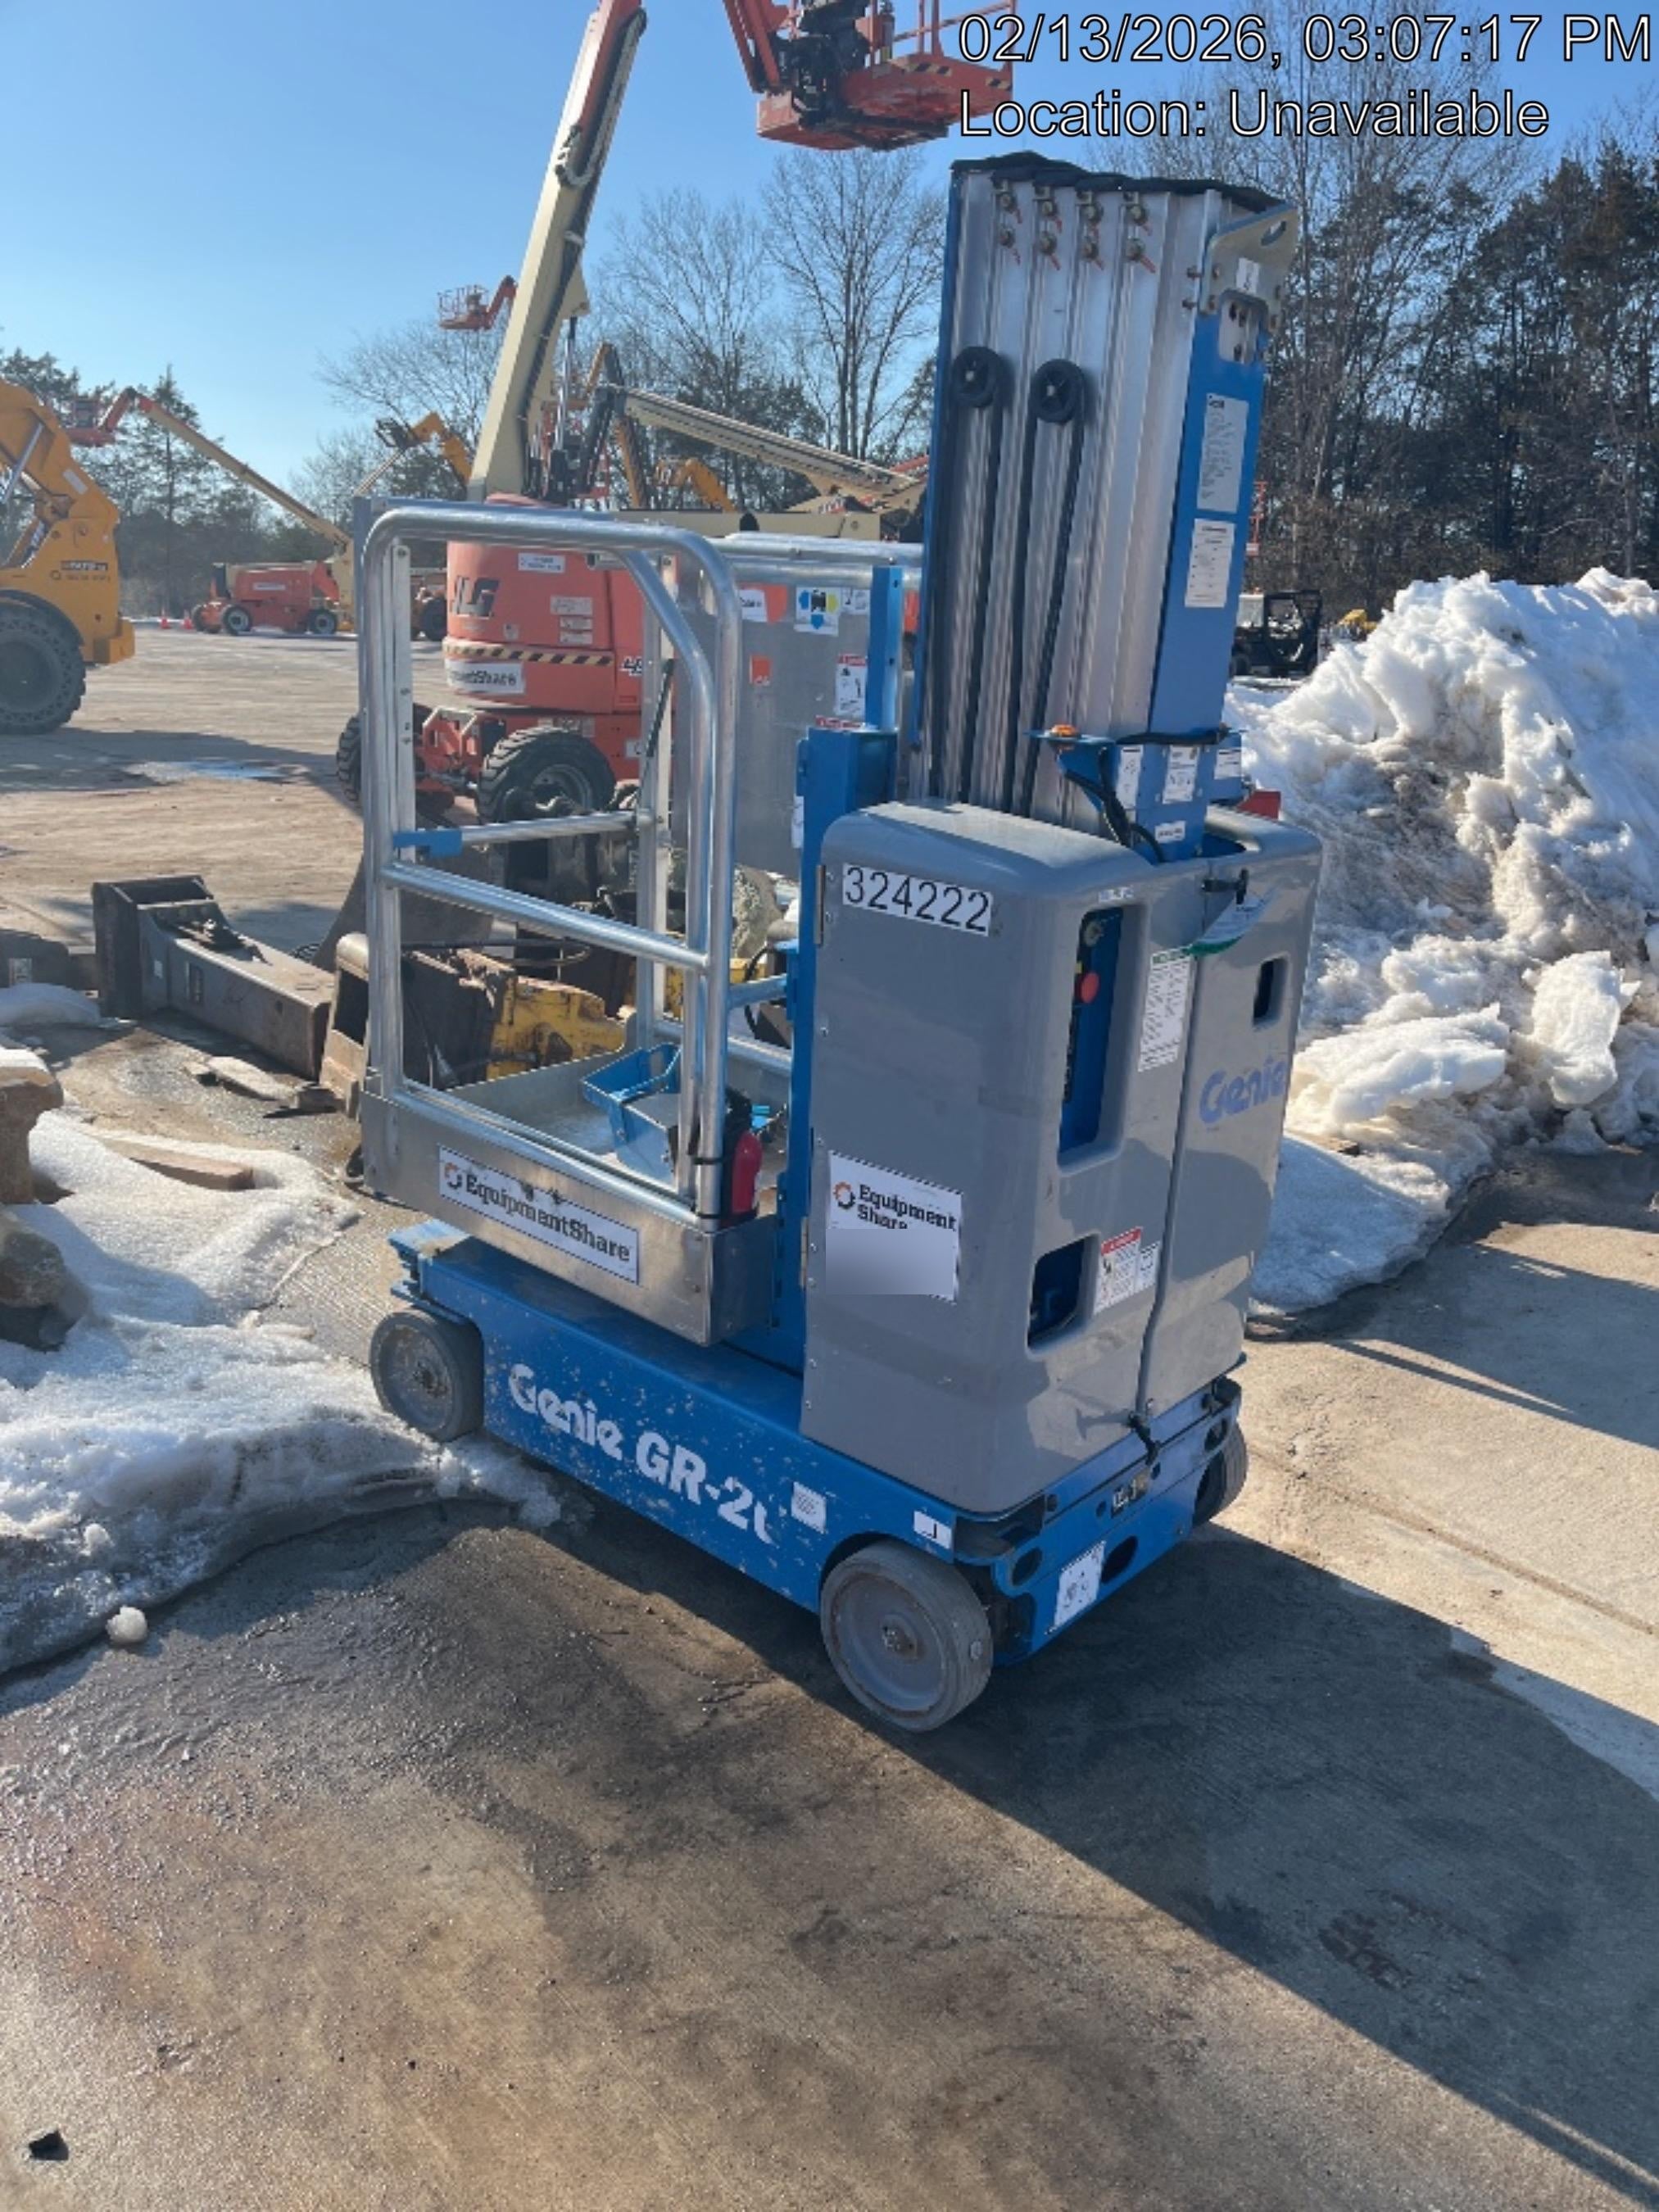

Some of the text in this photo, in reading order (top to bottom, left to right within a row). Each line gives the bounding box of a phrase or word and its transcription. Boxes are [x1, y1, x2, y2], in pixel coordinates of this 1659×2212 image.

[845, 867, 989, 931] 324222
[1199, 1055, 1287, 1125] Genie
[465, 1173, 630, 1262] EquipmentShare
[859, 1184, 957, 1231] Equipment
[508, 1363, 623, 1461] Genie
